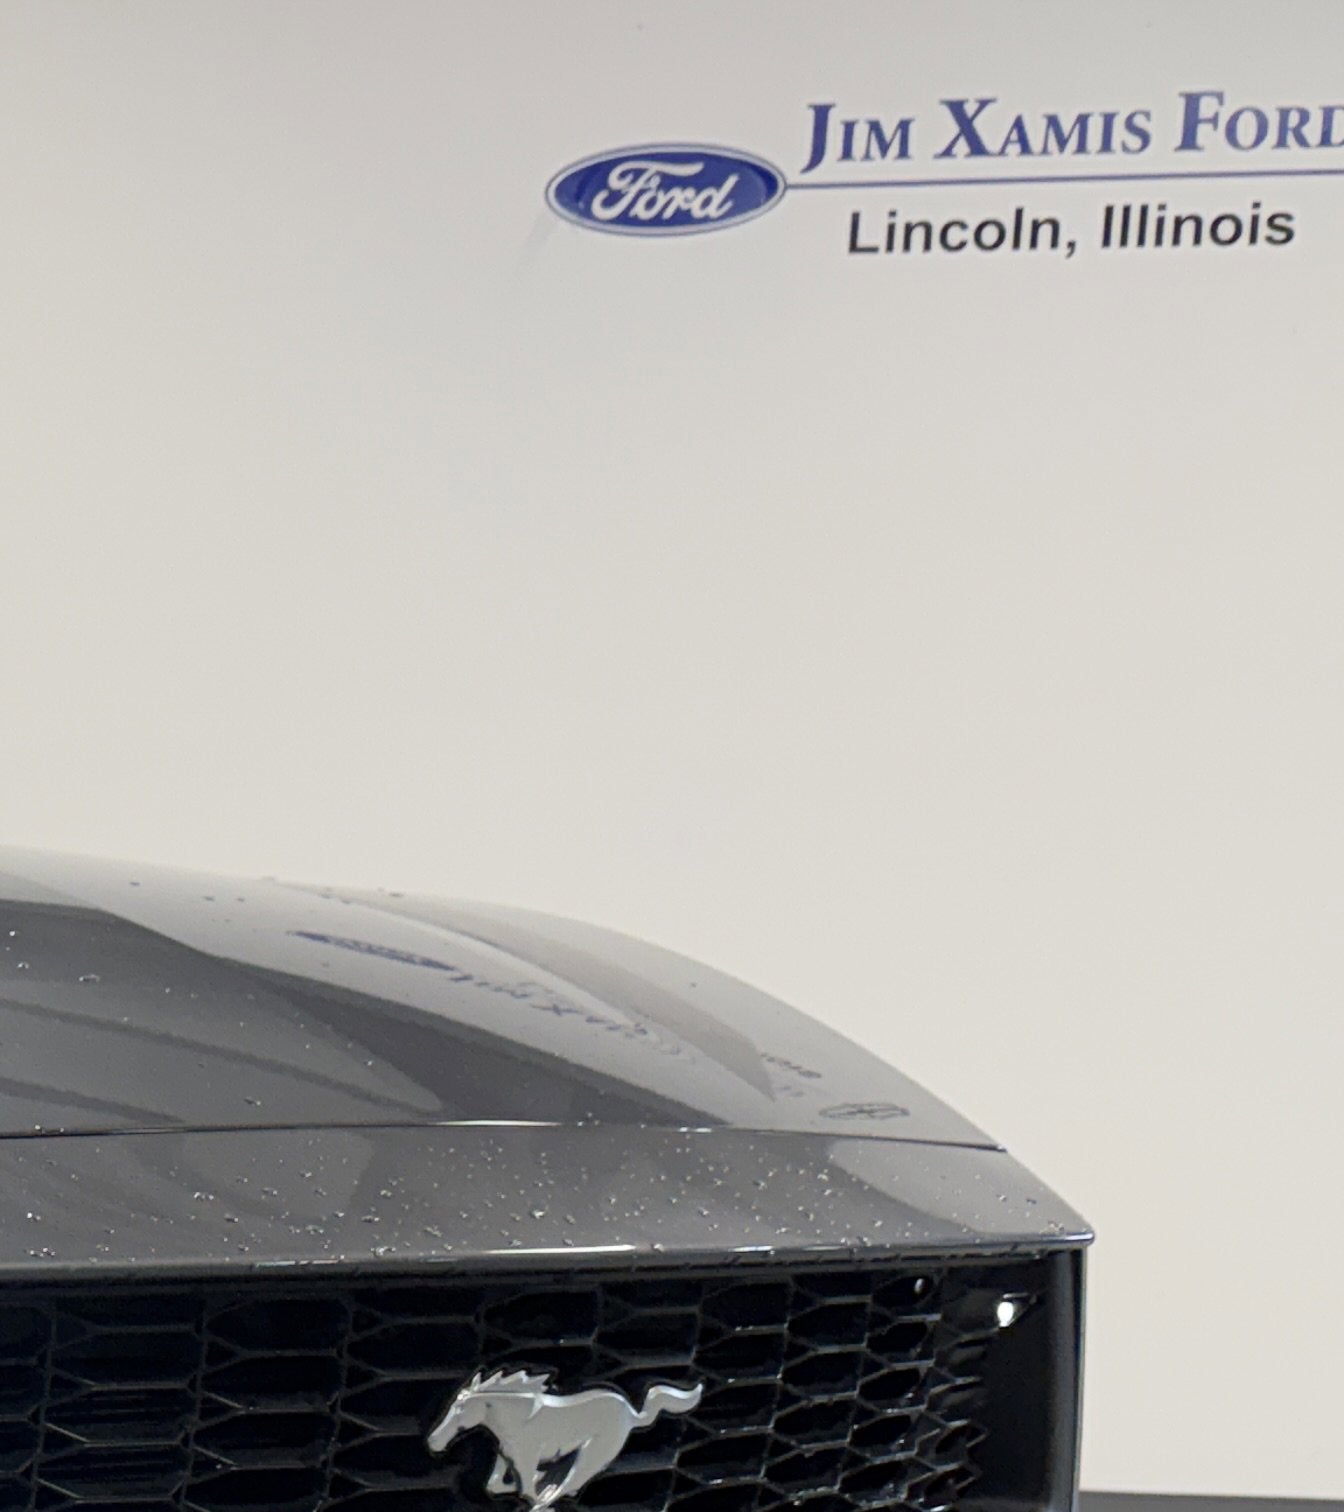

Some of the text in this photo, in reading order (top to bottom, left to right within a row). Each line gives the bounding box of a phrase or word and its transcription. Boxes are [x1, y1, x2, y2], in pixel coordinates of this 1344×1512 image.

[799, 103, 916, 175] JIM
[932, 97, 1153, 160] XAMIS
[591, 160, 740, 220] Ford
[847, 201, 1296, 259] Lincoln, Illinois
